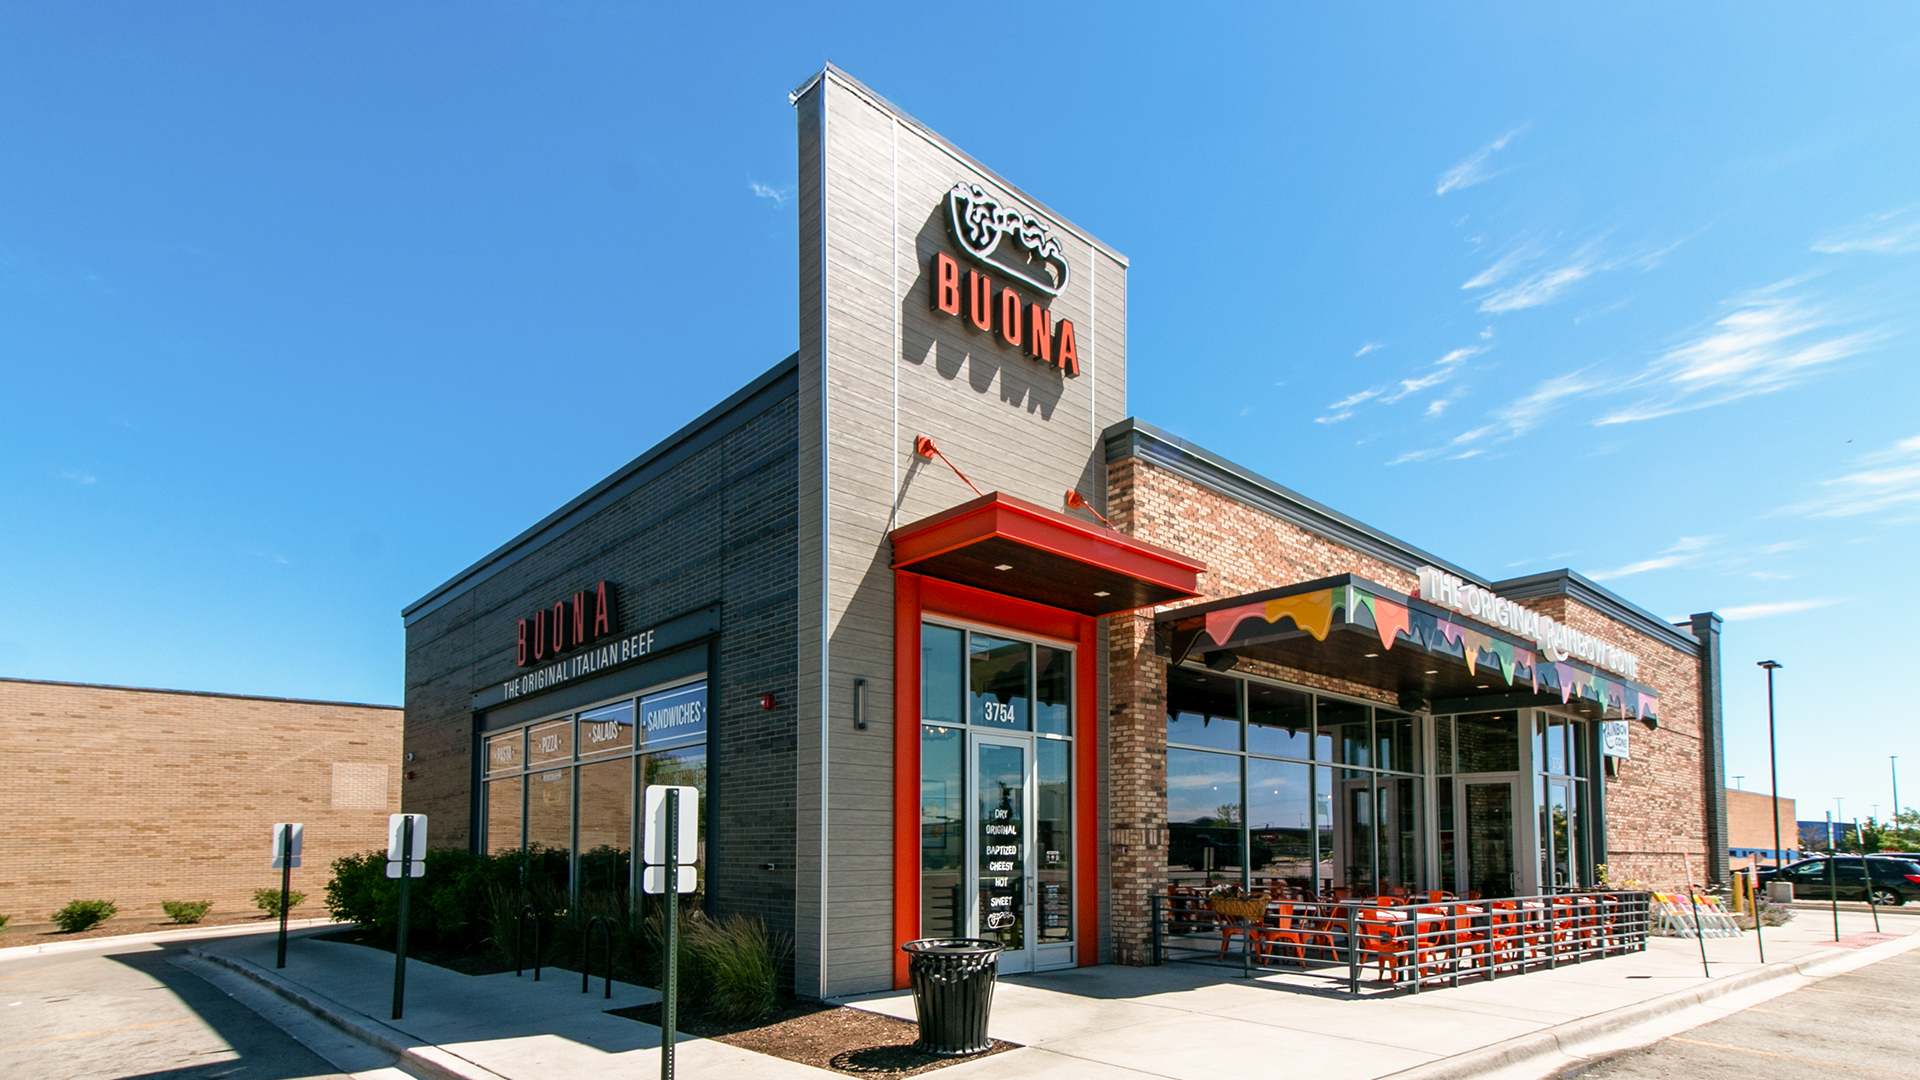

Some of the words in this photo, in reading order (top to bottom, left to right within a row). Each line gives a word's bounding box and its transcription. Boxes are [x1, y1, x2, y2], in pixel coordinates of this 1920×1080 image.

[937, 251, 1080, 377] BUONA
[516, 580, 609, 668] BUONA
[1425, 567, 1463, 609] THE
[1465, 584, 1543, 641] ORIGINAL
[1545, 616, 1607, 665] RAINBOW
[1607, 646, 1639, 679] CONE
[503, 681, 520, 700] THE
[522, 663, 569, 695] ORIGINAL
[572, 643, 618, 678] ITALIAN
[622, 629, 655, 661] BEEF
[647, 700, 702, 732] SANDWICHES
[984, 701, 1015, 723] 3754
[592, 720, 619, 743] SALADS
[496, 745, 512, 763] PASTA
[541, 734, 558, 754] PIZZA
[994, 809, 1008, 820] DRY
[985, 824, 1017, 836] ORIGINAL
[986, 844, 1017, 856] BAPTIZED
[989, 861, 1014, 872] CHEESY
[994, 877, 1009, 888] HOT
[990, 896, 1013, 908] SWEET
